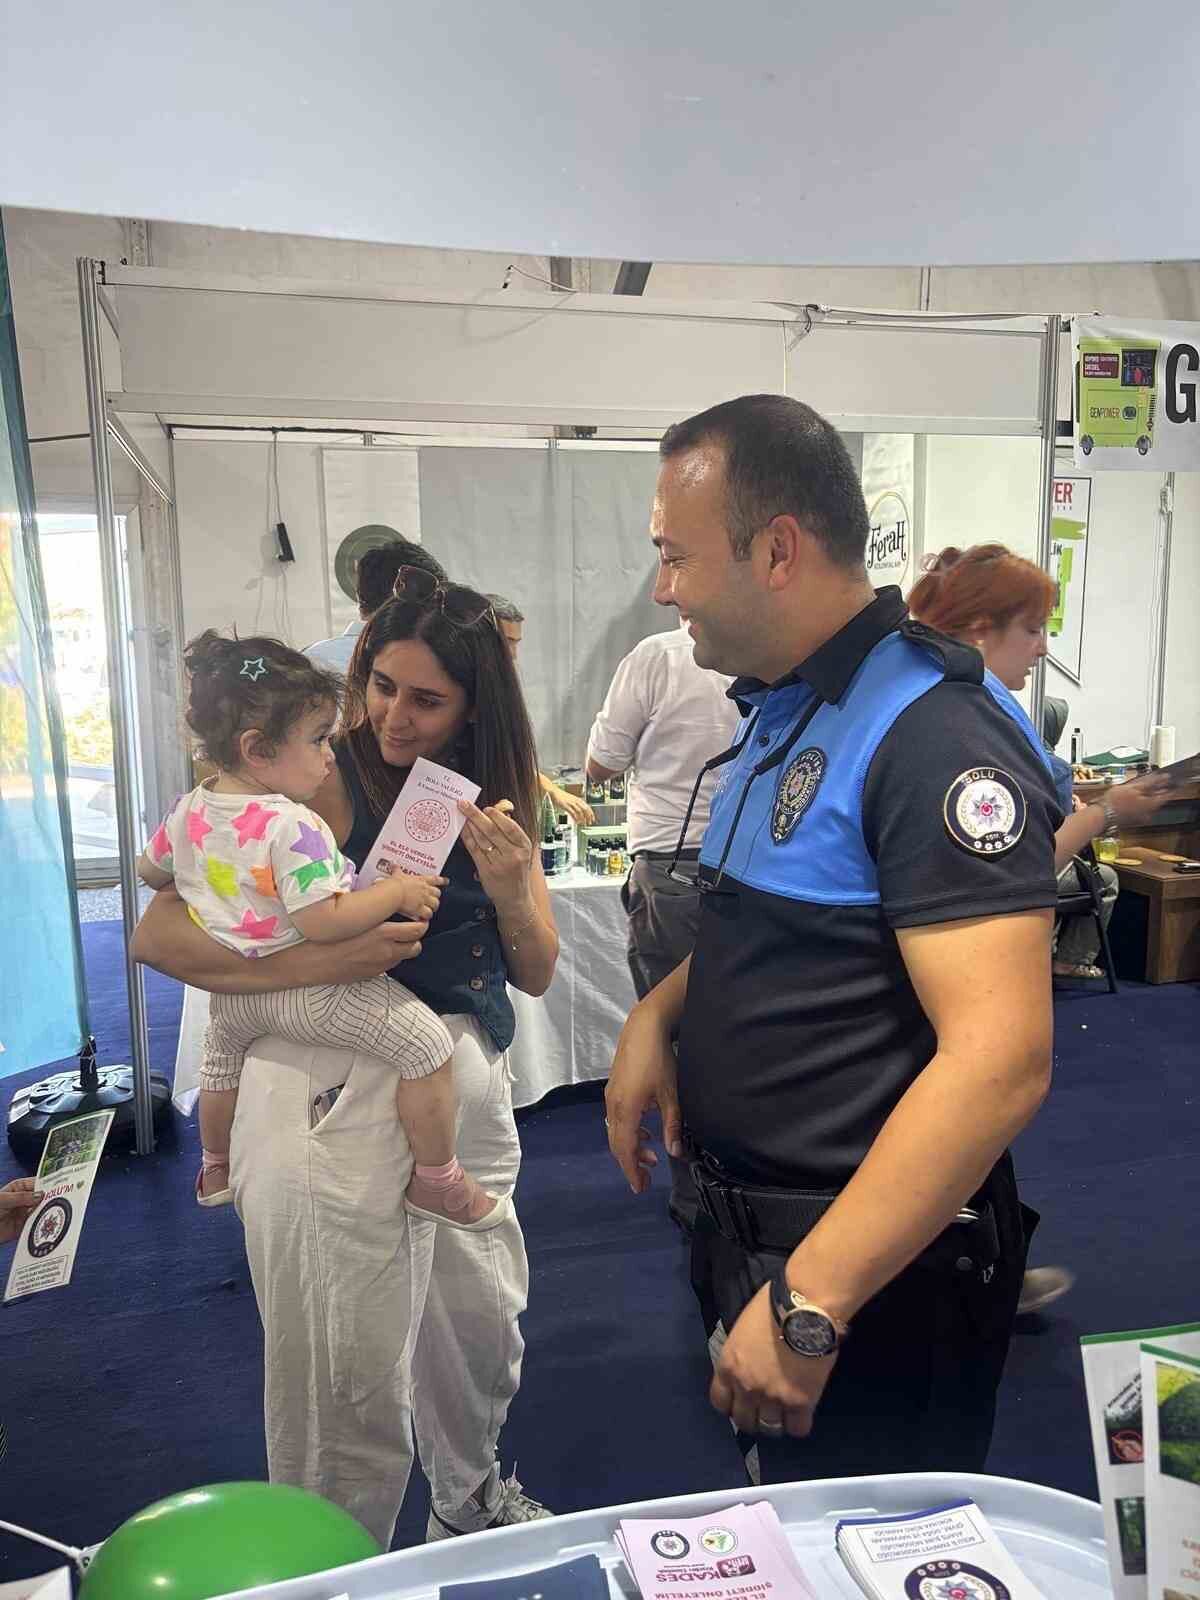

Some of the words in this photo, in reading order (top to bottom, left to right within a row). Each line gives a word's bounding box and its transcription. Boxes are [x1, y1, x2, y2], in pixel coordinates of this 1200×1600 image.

[1166, 344, 1199, 424] G
[1052, 482, 1073, 504] ER
[961, 770, 995, 785] BOLU
[656, 1571, 721, 1582] KADES
